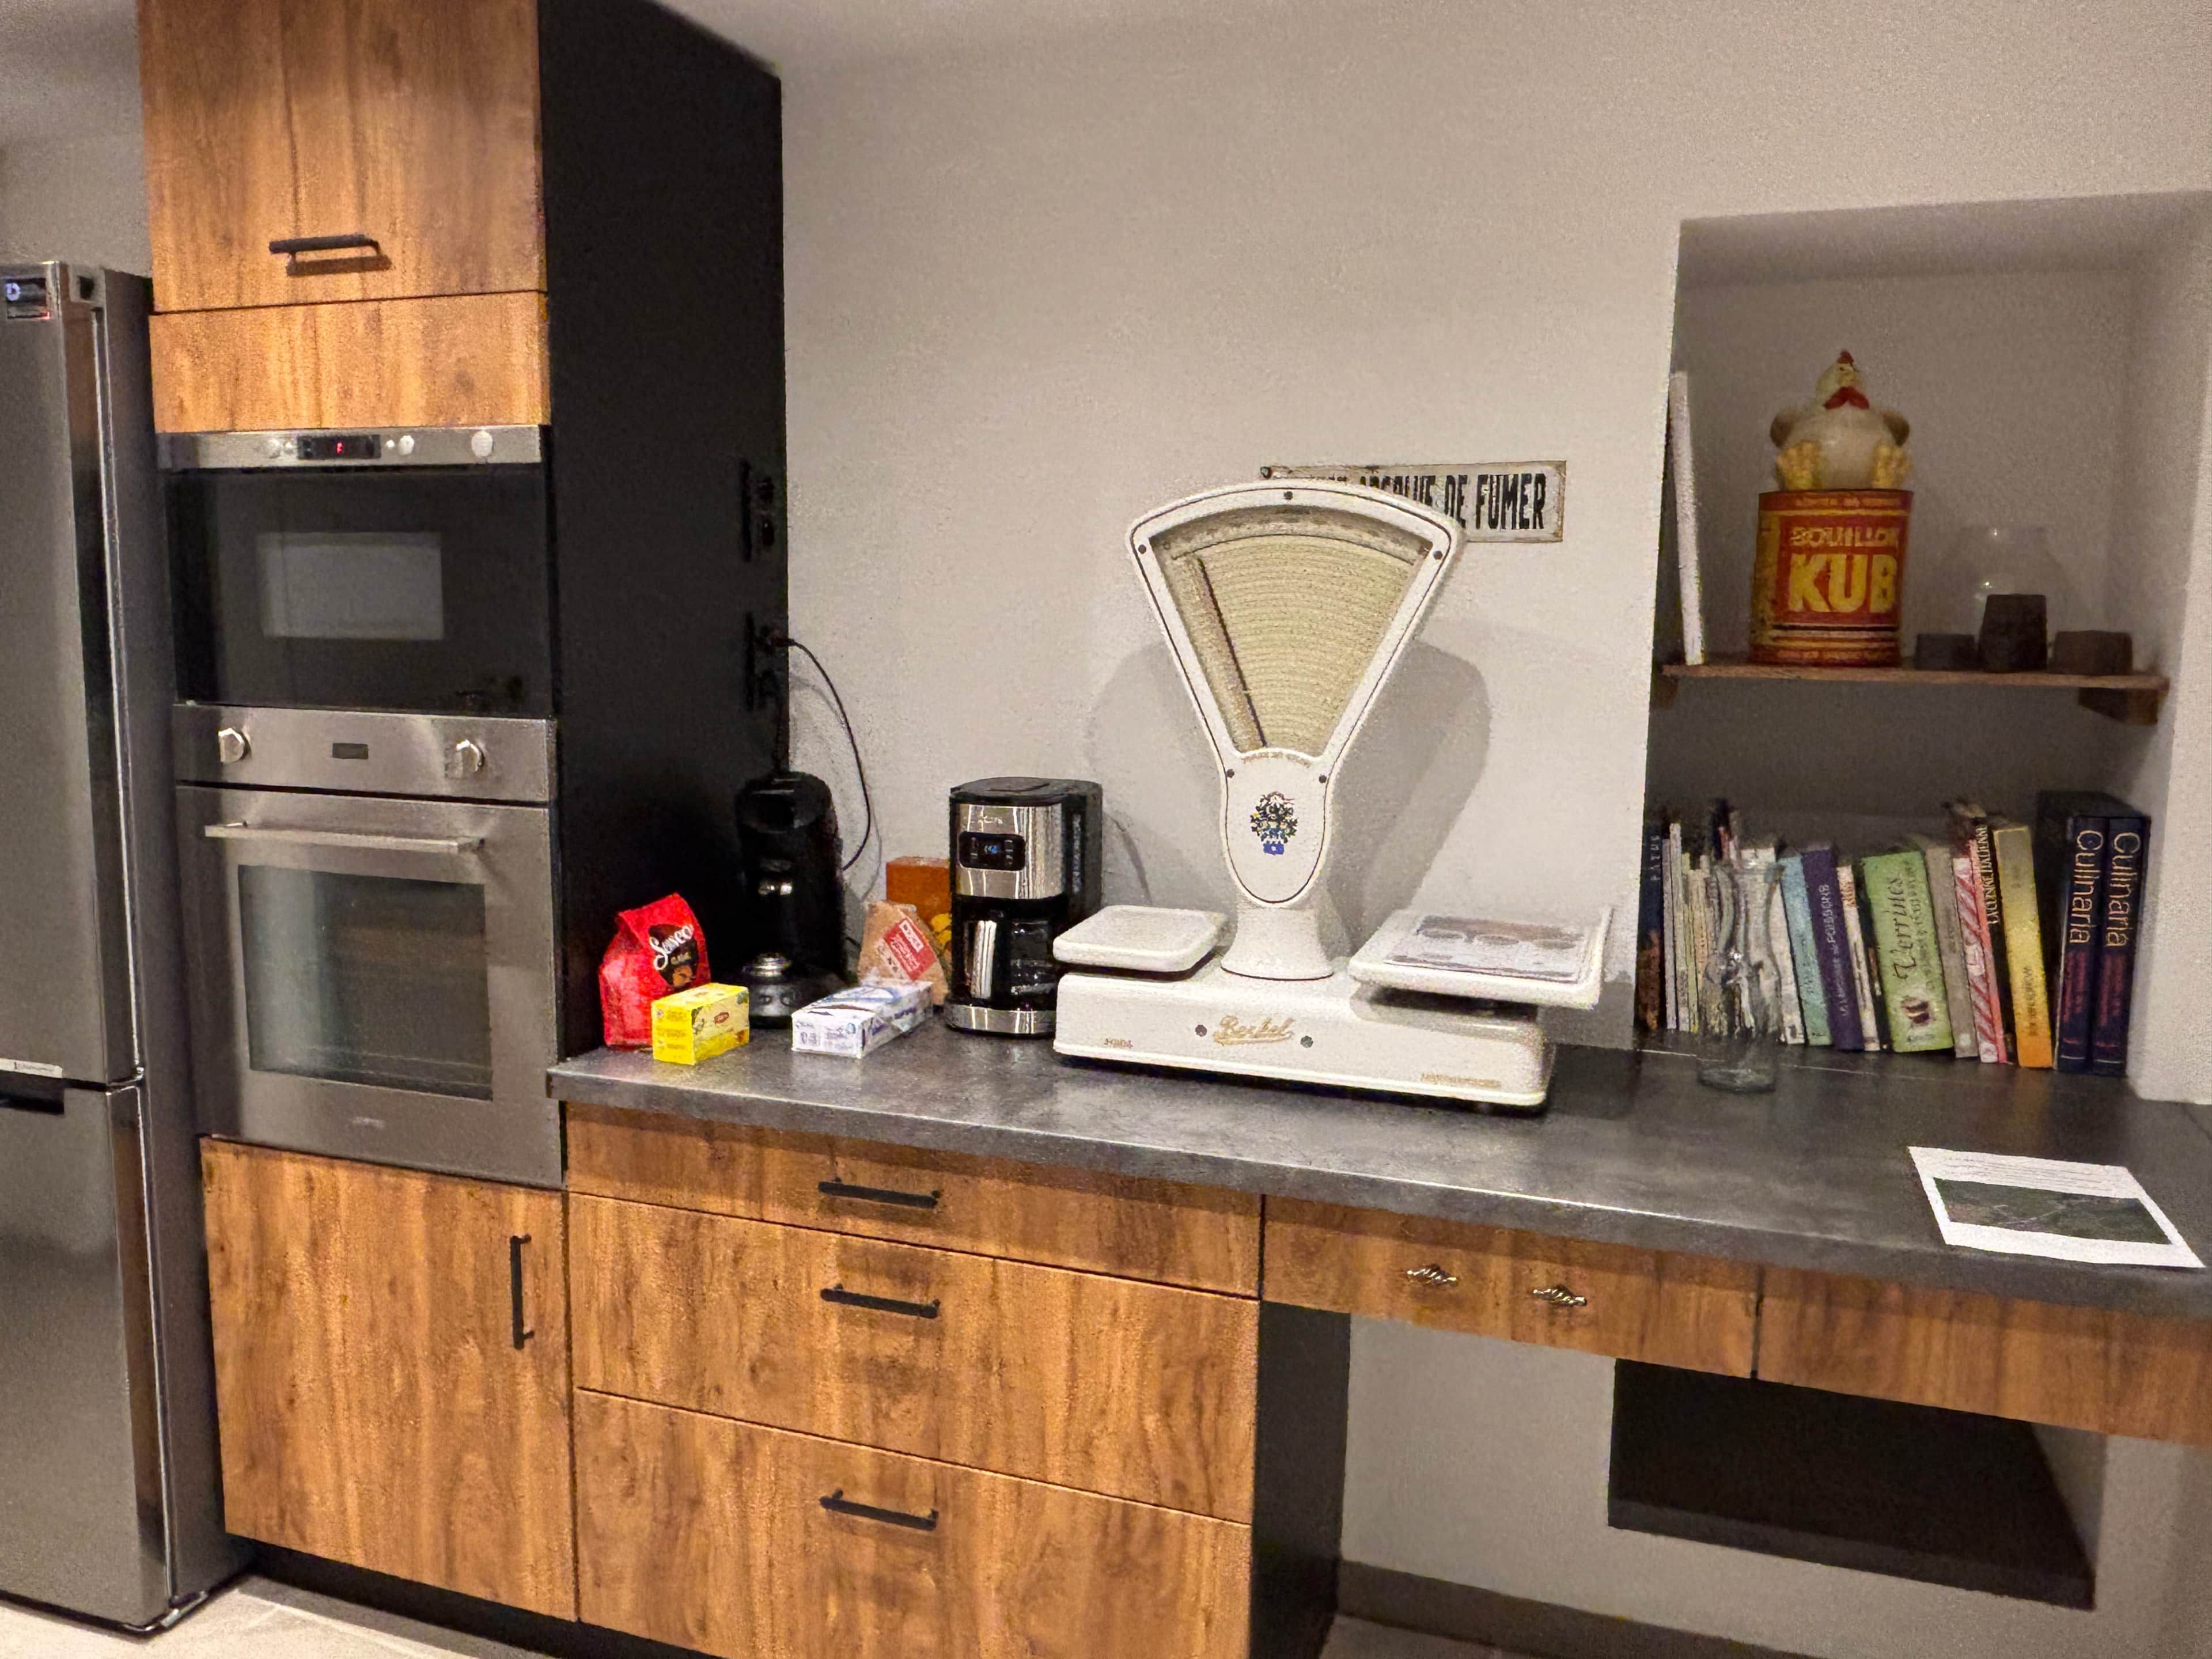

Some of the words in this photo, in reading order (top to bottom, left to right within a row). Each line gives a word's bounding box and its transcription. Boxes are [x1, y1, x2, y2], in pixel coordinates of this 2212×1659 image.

[1444, 474, 1468, 529] DE
[1475, 473, 1547, 530] FUMER
[1787, 553, 1898, 613] KUB
[1881, 875, 1917, 980] Verrines
[2069, 829, 2104, 945] Culinaria
[2105, 831, 2141, 948] Culinaria
